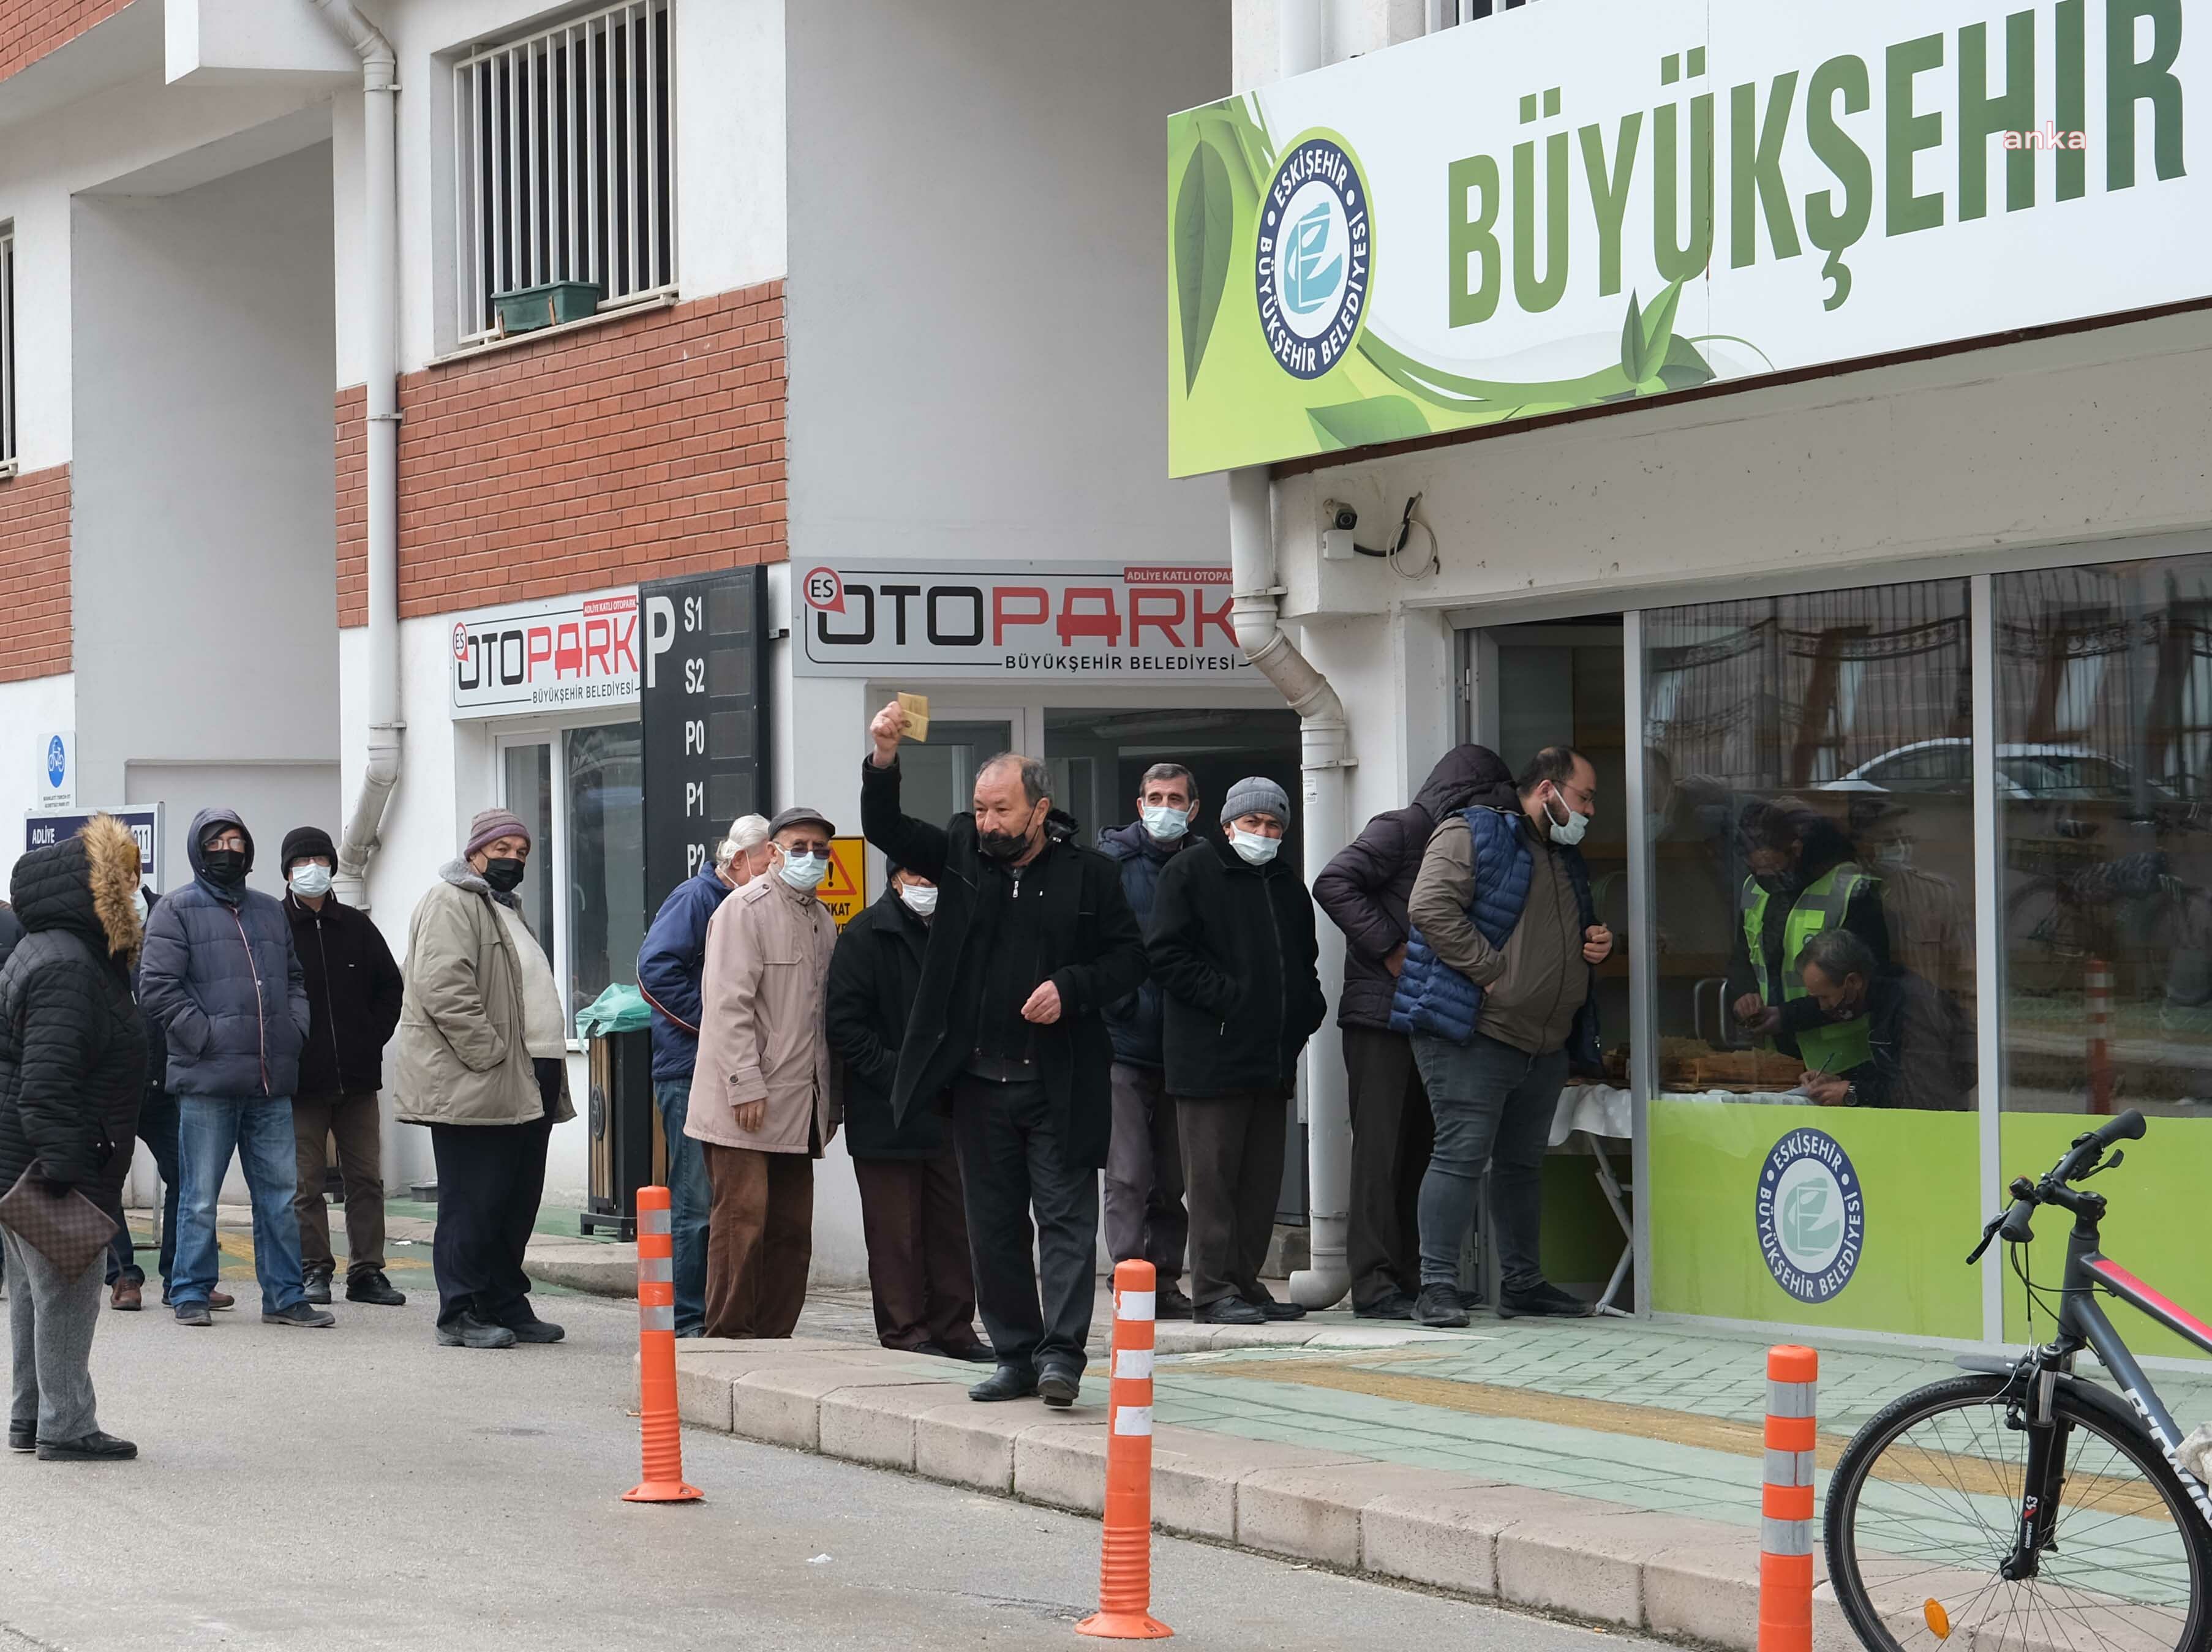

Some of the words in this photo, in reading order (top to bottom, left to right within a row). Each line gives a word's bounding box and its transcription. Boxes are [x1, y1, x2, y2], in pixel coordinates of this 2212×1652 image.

[1274, 149, 1347, 208] ESKİŞEHİR
[1258, 236, 1316, 372] BÜYÜKŞEHİR
[1321, 211, 1366, 365] BELEDİYESİ
[811, 579, 834, 598] ES
[1127, 569, 1161, 580] ADLİYE
[1163, 571, 1191, 580] KATLI
[684, 596, 702, 632] S1
[455, 632, 464, 650] ES
[459, 615, 638, 691] OTOPARK
[646, 596, 675, 688] P
[685, 658, 705, 694] S2
[1006, 653, 1122, 673] BÜYÜKŞEHİR
[1130, 654, 1235, 670] BELEDİYESİ
[533, 684, 584, 704] BÜYÜKŞEHİR
[586, 678, 634, 698] BELEDİYESİ
[685, 719, 705, 756] P0
[686, 781, 704, 817] P1
[32, 824, 55, 844] ADLİYE
[687, 843, 705, 879] P2
[1773, 1132, 1843, 1173] ESKİŞEHİR
[1758, 1186, 1815, 1298] BÜYÜKŞEHİR
[1818, 1191, 1861, 1297] BELEDİYESİ
